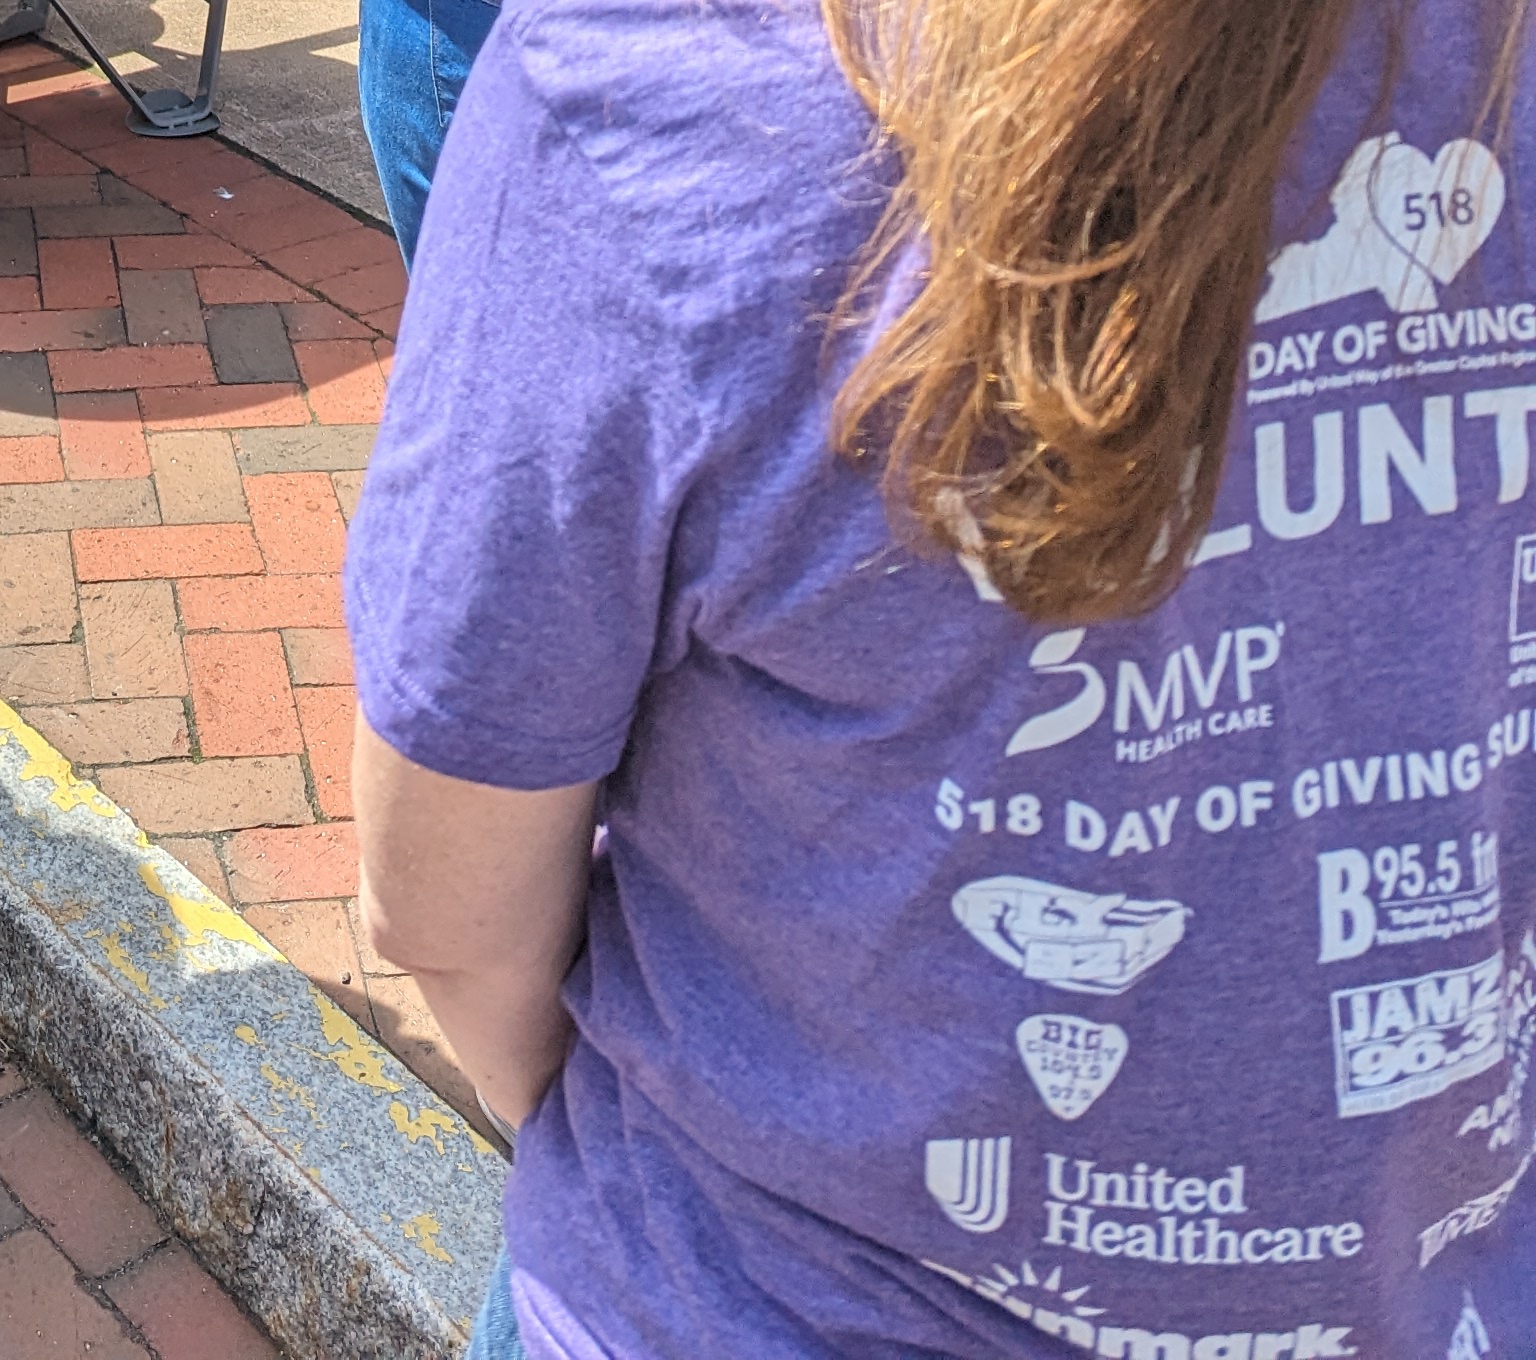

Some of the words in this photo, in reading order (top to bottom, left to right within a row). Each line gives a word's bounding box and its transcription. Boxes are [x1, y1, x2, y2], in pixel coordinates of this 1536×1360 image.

[1403, 188, 1475, 232] 518
[1248, 331, 1325, 380] DAY
[1332, 320, 1388, 365] OF
[1397, 303, 1536, 355] GIVING
[1113, 625, 1281, 734] MVP
[1116, 722, 1202, 765] HEALTH
[1208, 704, 1274, 737] CARE
[935, 777, 1043, 836] 518
[1066, 796, 1180, 856] DAY
[1196, 780, 1275, 832] OF
[1291, 743, 1482, 818] GIVING
[1041, 1019, 1104, 1044] BIG
[1348, 956, 1504, 1043] JAMZ
[1350, 1013, 1497, 1087] 96.3
[1043, 1152, 1248, 1215] United
[1043, 1200, 1364, 1265] Healthcare
